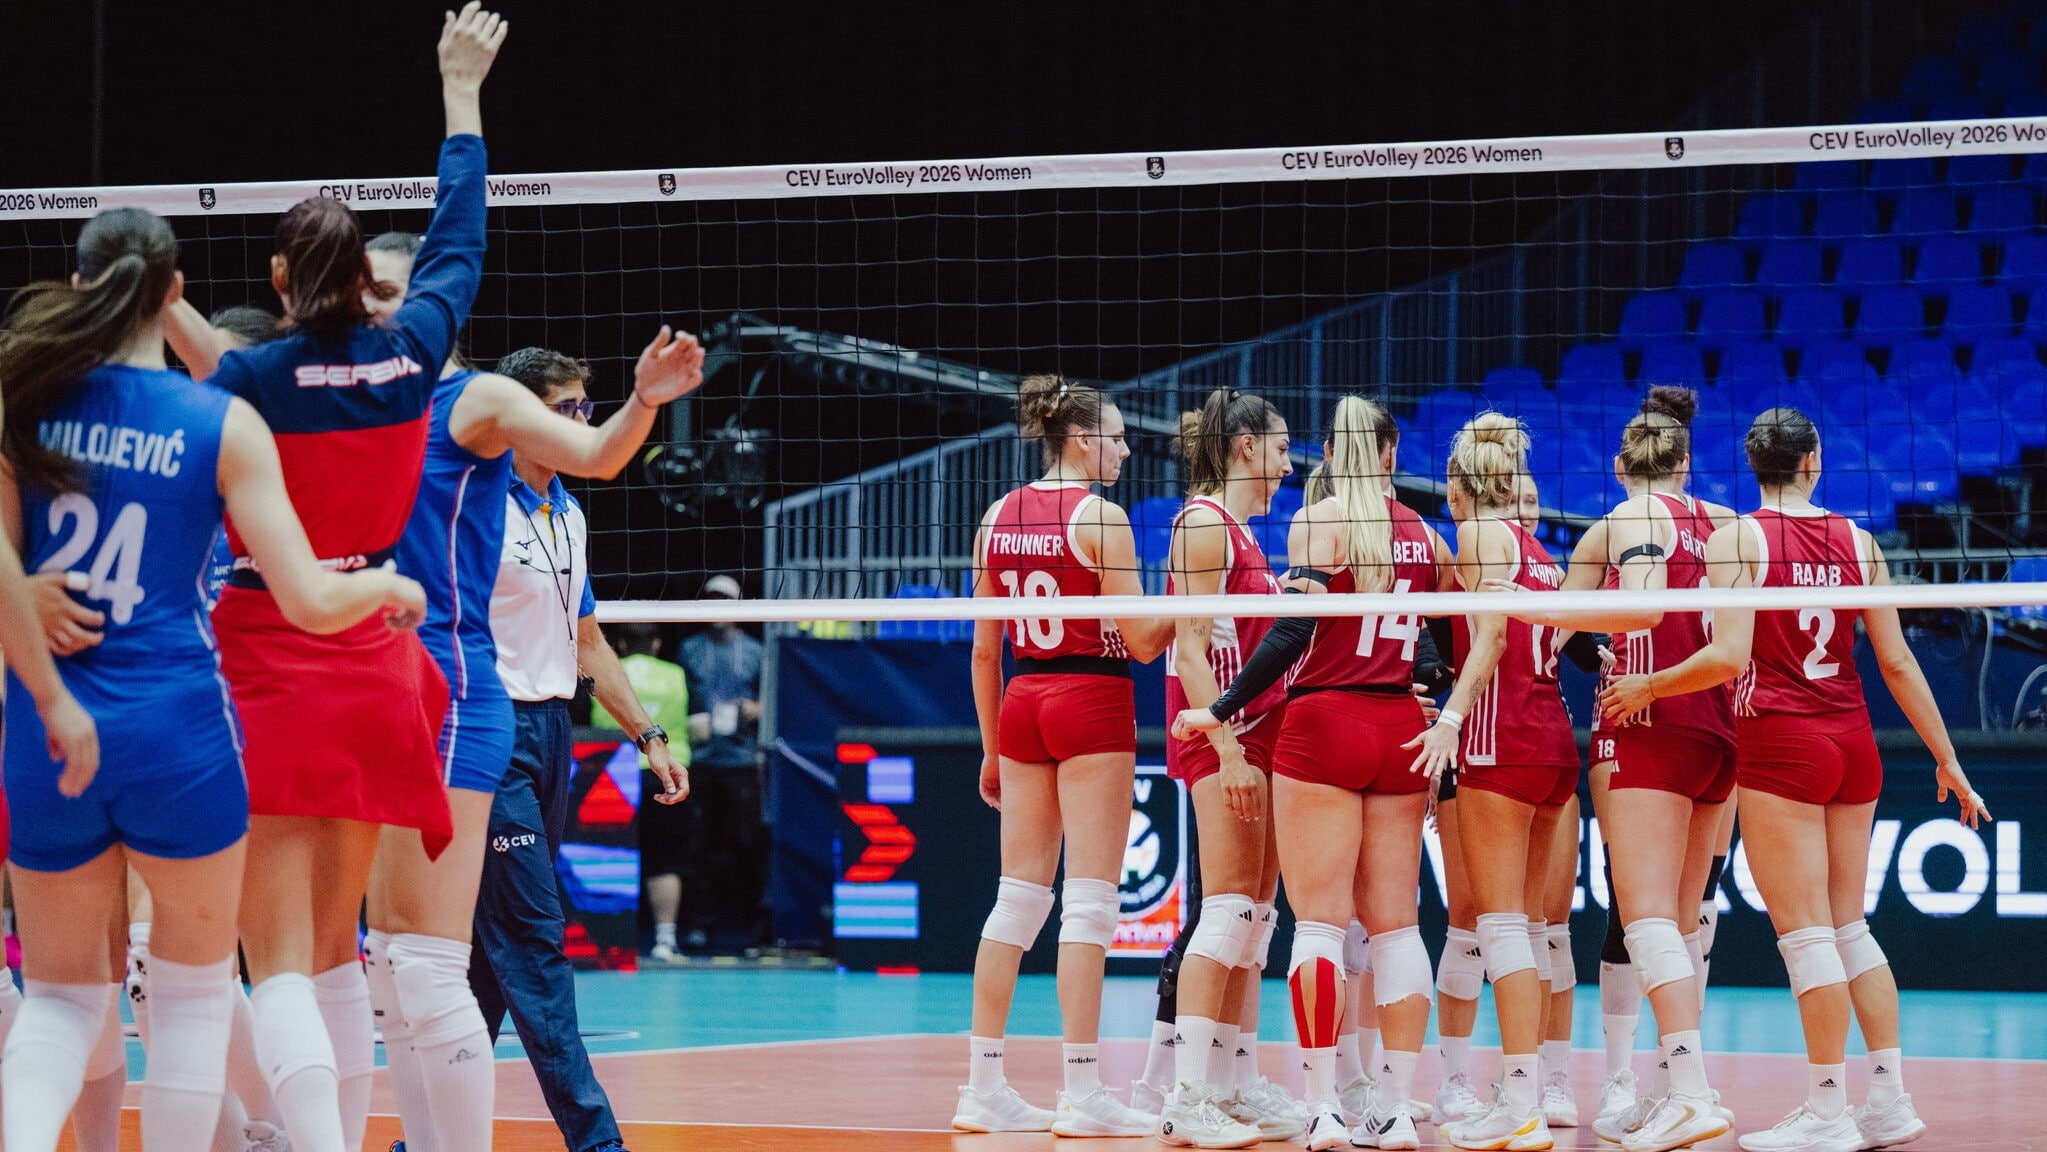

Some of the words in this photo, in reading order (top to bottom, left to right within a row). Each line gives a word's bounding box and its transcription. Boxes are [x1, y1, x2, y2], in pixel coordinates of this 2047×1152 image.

[1810, 131, 1849, 150] CEV
[1855, 127, 1954, 149] EuroVolley
[1961, 125, 2007, 143] 2026
[1282, 152, 1318, 170] CEV
[1324, 148, 1418, 170] EuroVolley
[1424, 147, 1468, 165] 2026
[1472, 145, 1543, 163] Women
[786, 169, 821, 187] CEV
[826, 166, 914, 188] EuroVolley
[919, 165, 961, 183] 2026
[965, 163, 1032, 181] Women
[0, 194, 35, 211] 2026
[39, 193, 98, 210] Women
[319, 184, 352, 202] CEV
[488, 180, 551, 197] Women
[38, 420, 185, 478] MILOJEVIĆ
[993, 533, 1064, 557] TRUNNER
[37, 491, 148, 625] 24
[1792, 562, 1842, 587] RAAB
[999, 570, 1065, 650] 10
[1355, 578, 1420, 662] 14
[1798, 608, 1840, 680] 2
[1597, 738, 1615, 759] 18
[511, 834, 535, 847] CEV
